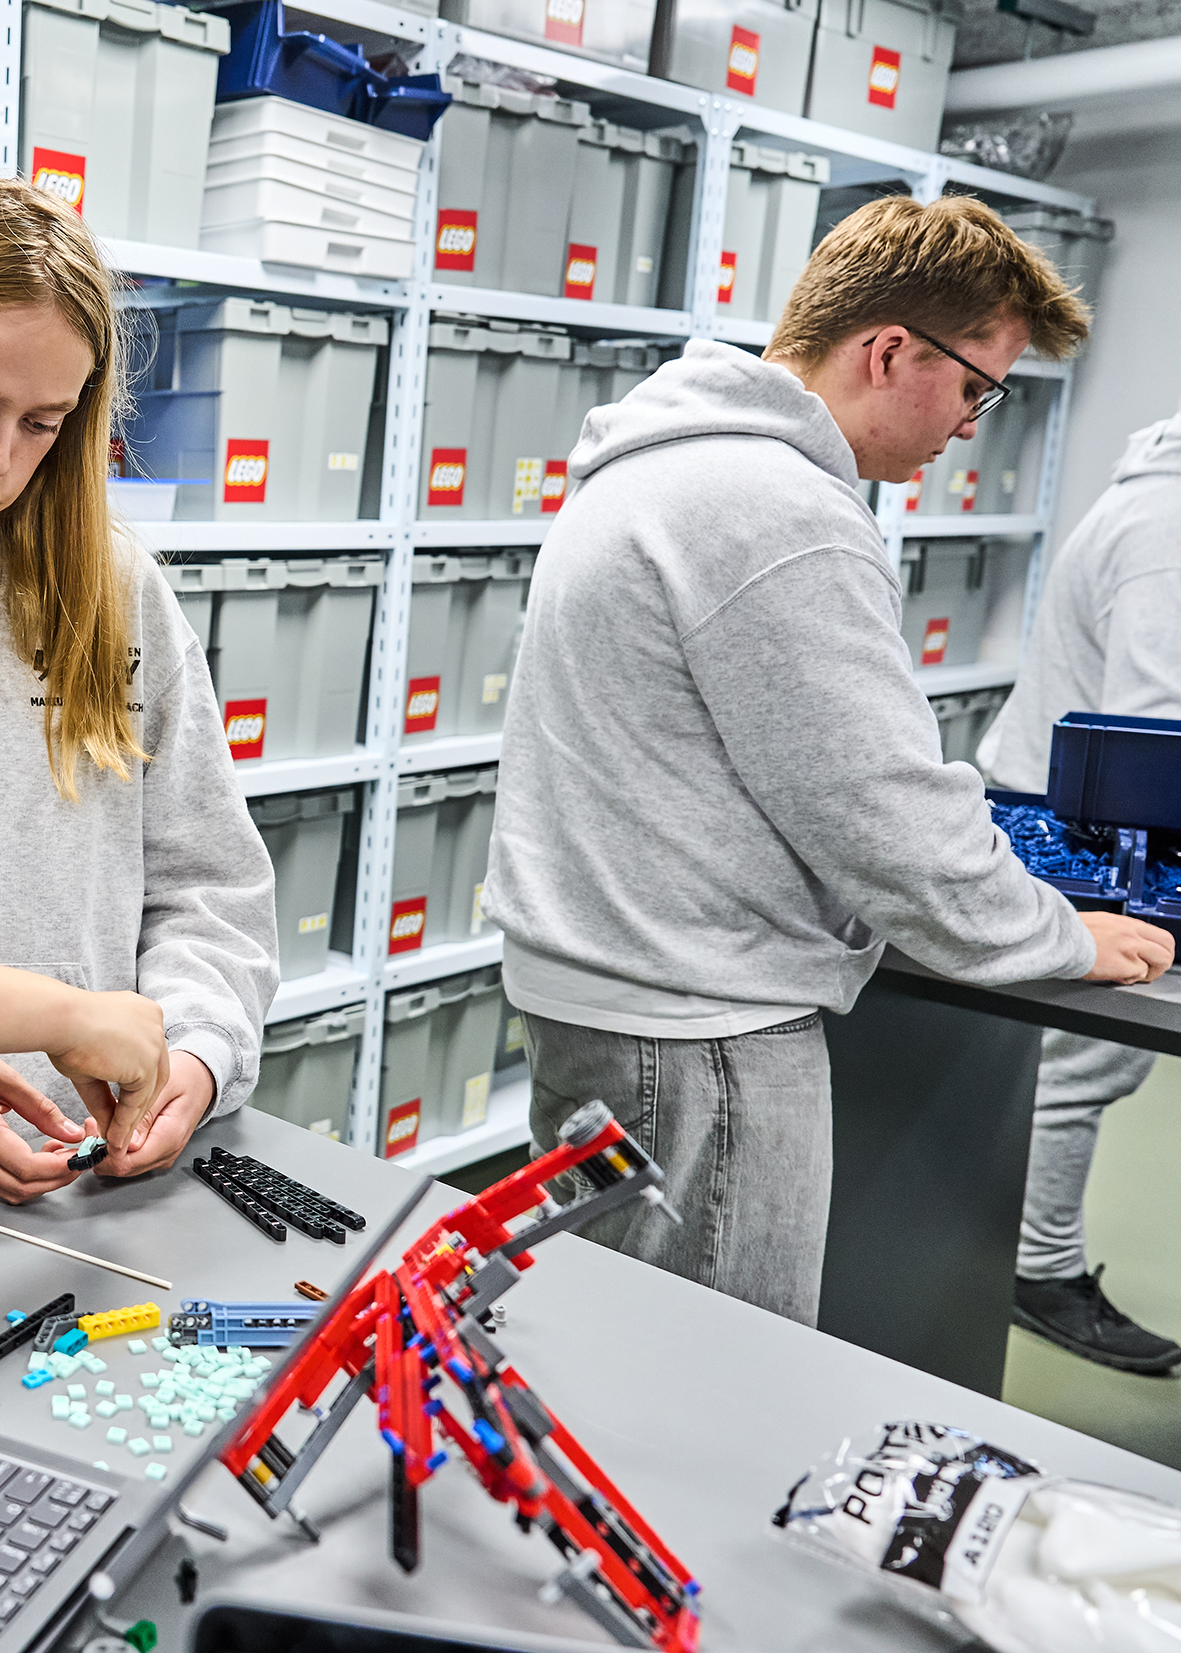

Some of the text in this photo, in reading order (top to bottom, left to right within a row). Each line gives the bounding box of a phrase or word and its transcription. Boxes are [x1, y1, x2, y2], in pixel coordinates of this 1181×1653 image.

[438, 227, 475, 252] LEGO
[227, 459, 266, 483] LEGO
[431, 466, 464, 488] LEGO
[407, 692, 437, 716] LEGO
[226, 716, 264, 742] LEGO
